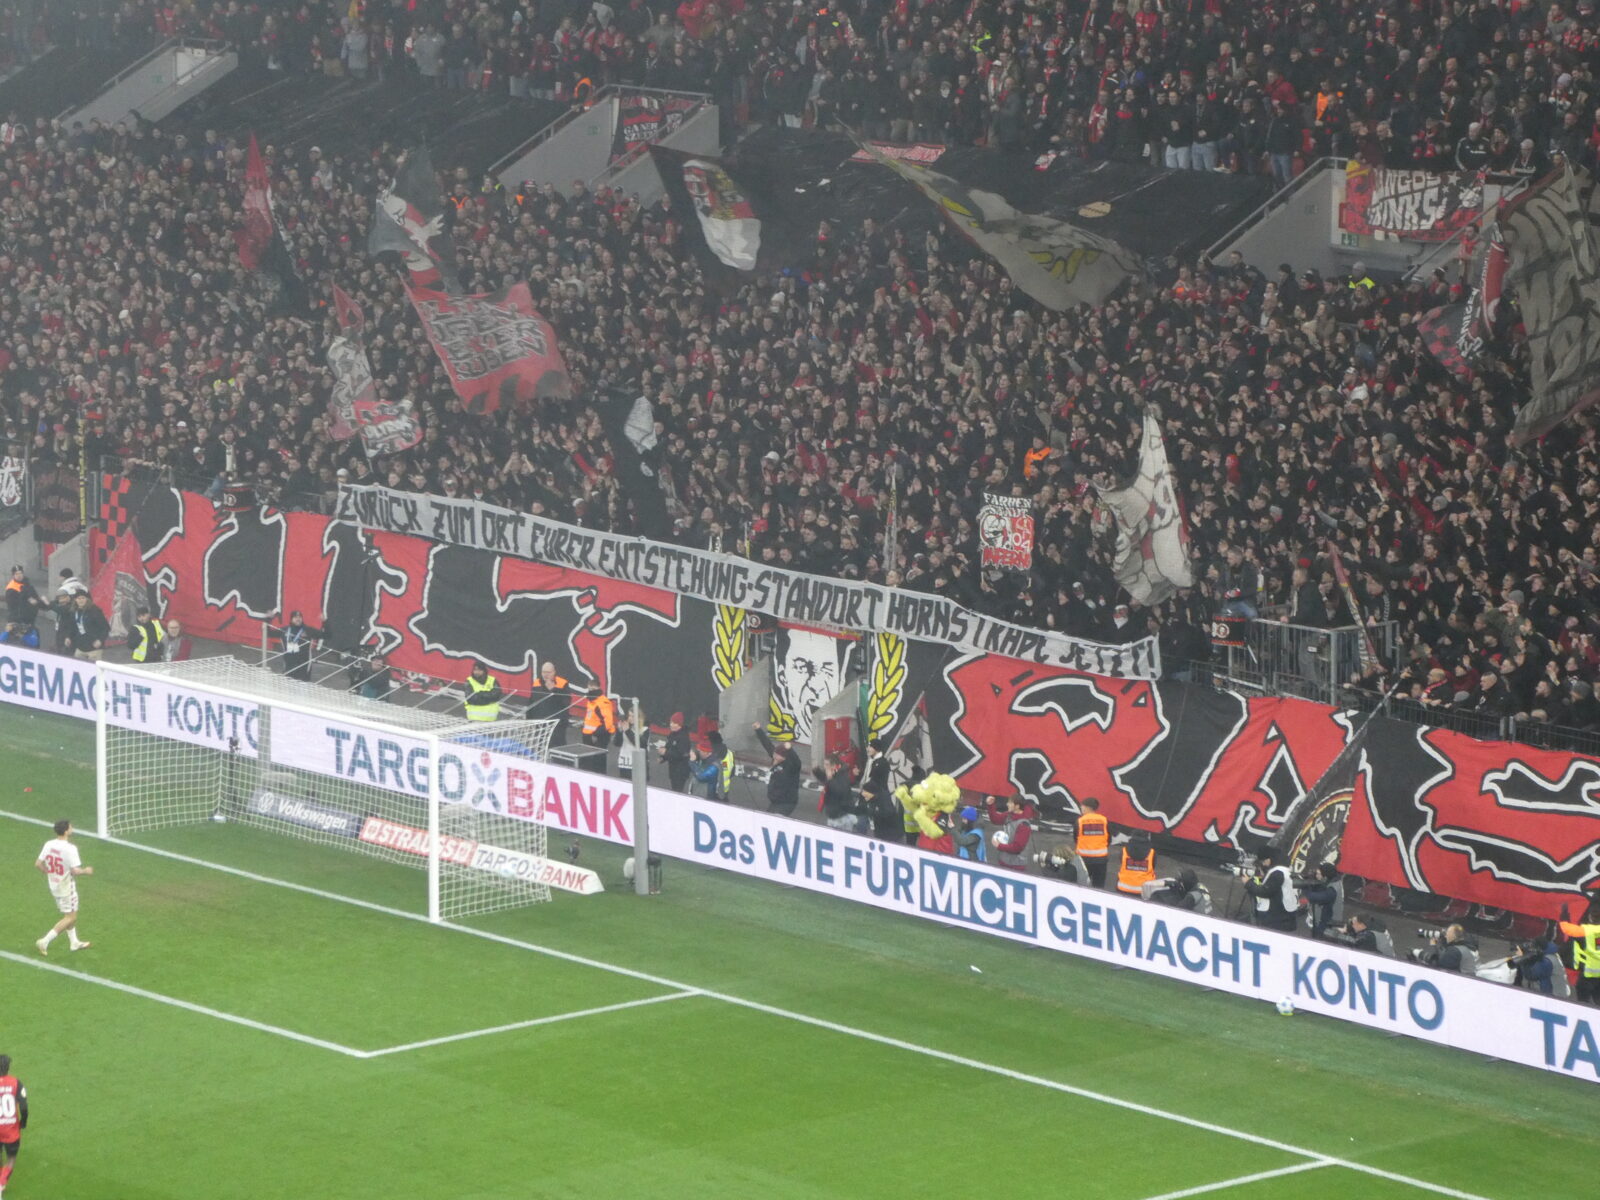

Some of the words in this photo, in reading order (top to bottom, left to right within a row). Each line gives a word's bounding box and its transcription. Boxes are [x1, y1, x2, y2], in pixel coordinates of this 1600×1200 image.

[338, 486, 422, 531] ZURÜCK
[430, 501, 476, 544] ZUM
[481, 509, 525, 553] ORT
[531, 522, 598, 571] EURER
[0, 655, 151, 722] GEMACHT
[278, 797, 348, 830] Volkswagen
[45, 854, 65, 876] 35
[693, 810, 755, 864] Das
[761, 826, 834, 884] WIE
[844, 840, 914, 904] FÜR
[923, 863, 1033, 933] MICH
[1046, 894, 1270, 988] GEMACHT
[1292, 951, 1445, 1030] KONTO
